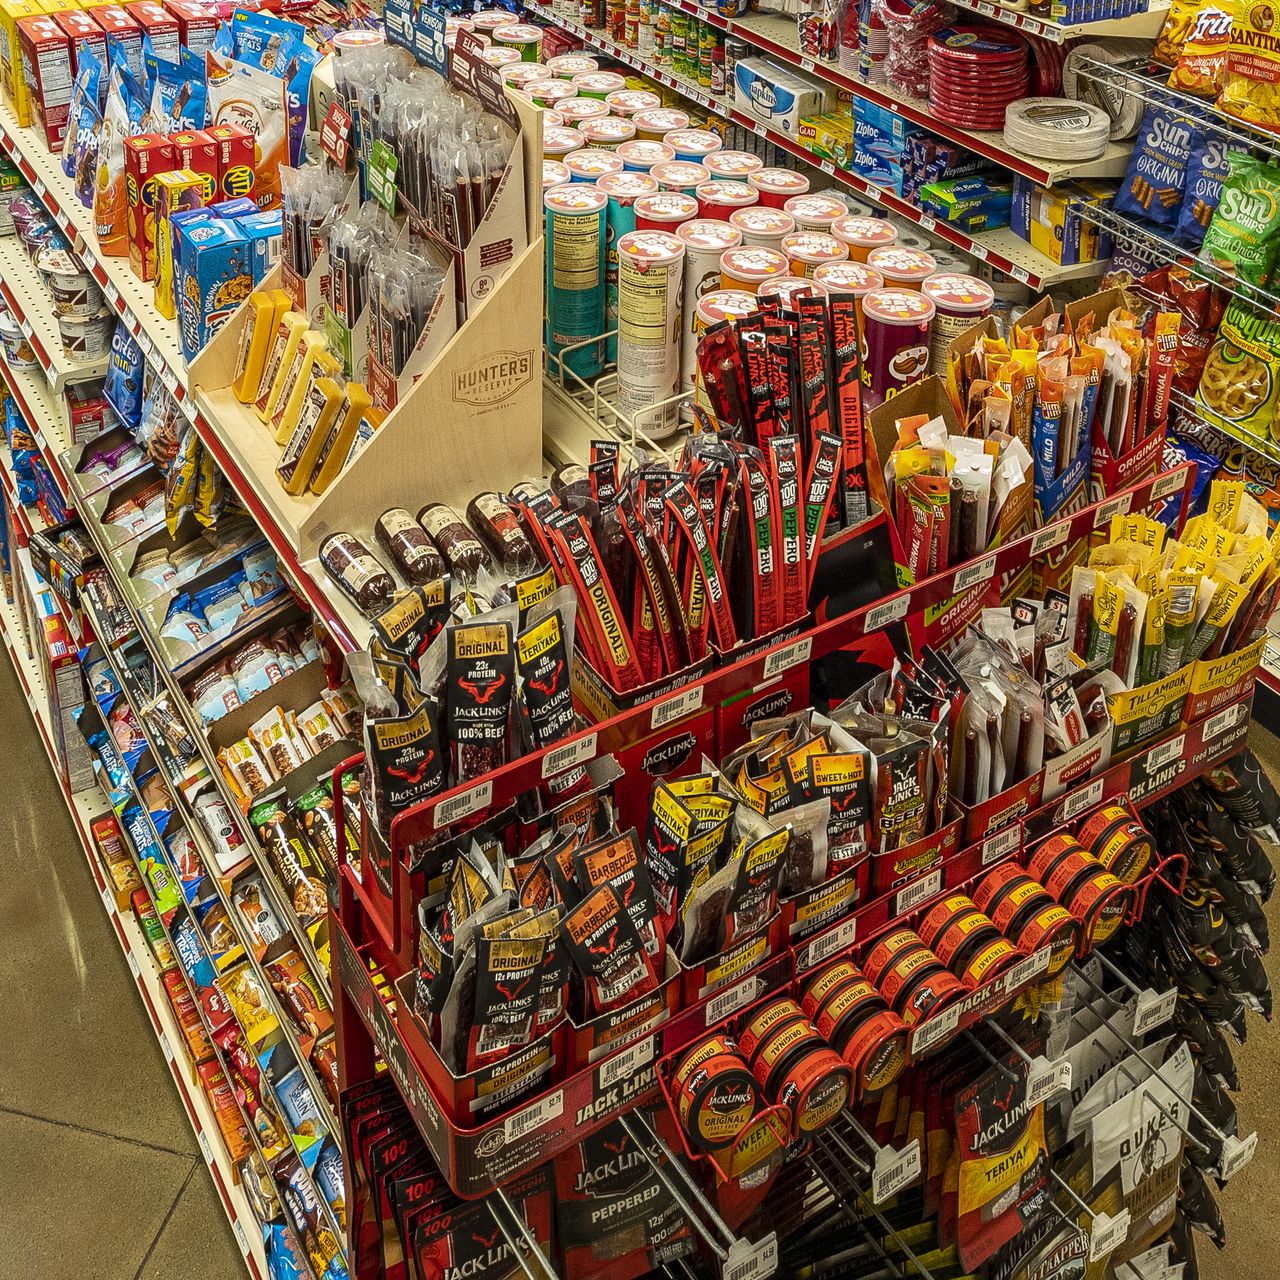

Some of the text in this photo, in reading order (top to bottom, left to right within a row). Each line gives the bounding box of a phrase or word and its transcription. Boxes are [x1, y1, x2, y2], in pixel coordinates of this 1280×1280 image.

[421, 12, 443, 31] VENISON
[750, 82, 777, 106] napkins
[799, 126, 816, 137] GLAD
[854, 120, 878, 138] Ziploc
[854, 150, 878, 168] Ziploc
[1159, 139, 1191, 160] CHIPS
[1220, 187, 1267, 221] Sun
[1233, 212, 1266, 234] CHIPS
[458, 358, 528, 390] HUNTER'S
[1154, 372, 1168, 419] ORIGINAL
[843, 397, 857, 453] ORIGINAL
[1044, 437, 1054, 463] MILD
[1118, 433, 1163, 474] ORIGINAL
[1062, 461, 1082, 488] MILD
[555, 513, 578, 528] ORIGINAL
[521, 584, 556, 607] TERIYAKI
[389, 608, 424, 639] ORIGINAL
[592, 587, 624, 655] ORIGINAL
[458, 641, 505, 656] ORIGINAL
[522, 632, 558, 661] TERIYAKI
[468, 669, 496, 679] PROTEIN
[1207, 644, 1262, 681] TILLAMOOK
[1128, 671, 1189, 711] TILLAMOOK
[453, 706, 476, 718] JACK
[381, 725, 429, 748] ORIGINAL
[458, 726, 505, 739] 100% BEEF
[642, 752, 668, 770] JACK
[831, 782, 858, 793] PROTEIN
[893, 776, 917, 796] JACK
[655, 801, 687, 834] TERIYAKI
[590, 851, 635, 883] BARBECUE
[573, 898, 618, 940] BARBECUE
[492, 954, 540, 970] ORIGINAL
[719, 948, 756, 977] TERIYAKI
[510, 969, 535, 981] PROTEIN
[619, 1001, 652, 1023] PROTEIN
[506, 1048, 538, 1071] PROTEIN
[708, 1095, 729, 1106] JACK
[704, 1115, 745, 1127] ORIGINAL
[1120, 1100, 1180, 1159] DUKE'S
[970, 1121, 1005, 1151] JACK
[381, 1142, 408, 1164] 100
[575, 1161, 617, 1192] JACK
[405, 1181, 434, 1201] 100
[591, 1184, 661, 1223] PEPPERED
[424, 1216, 451, 1236] 100
